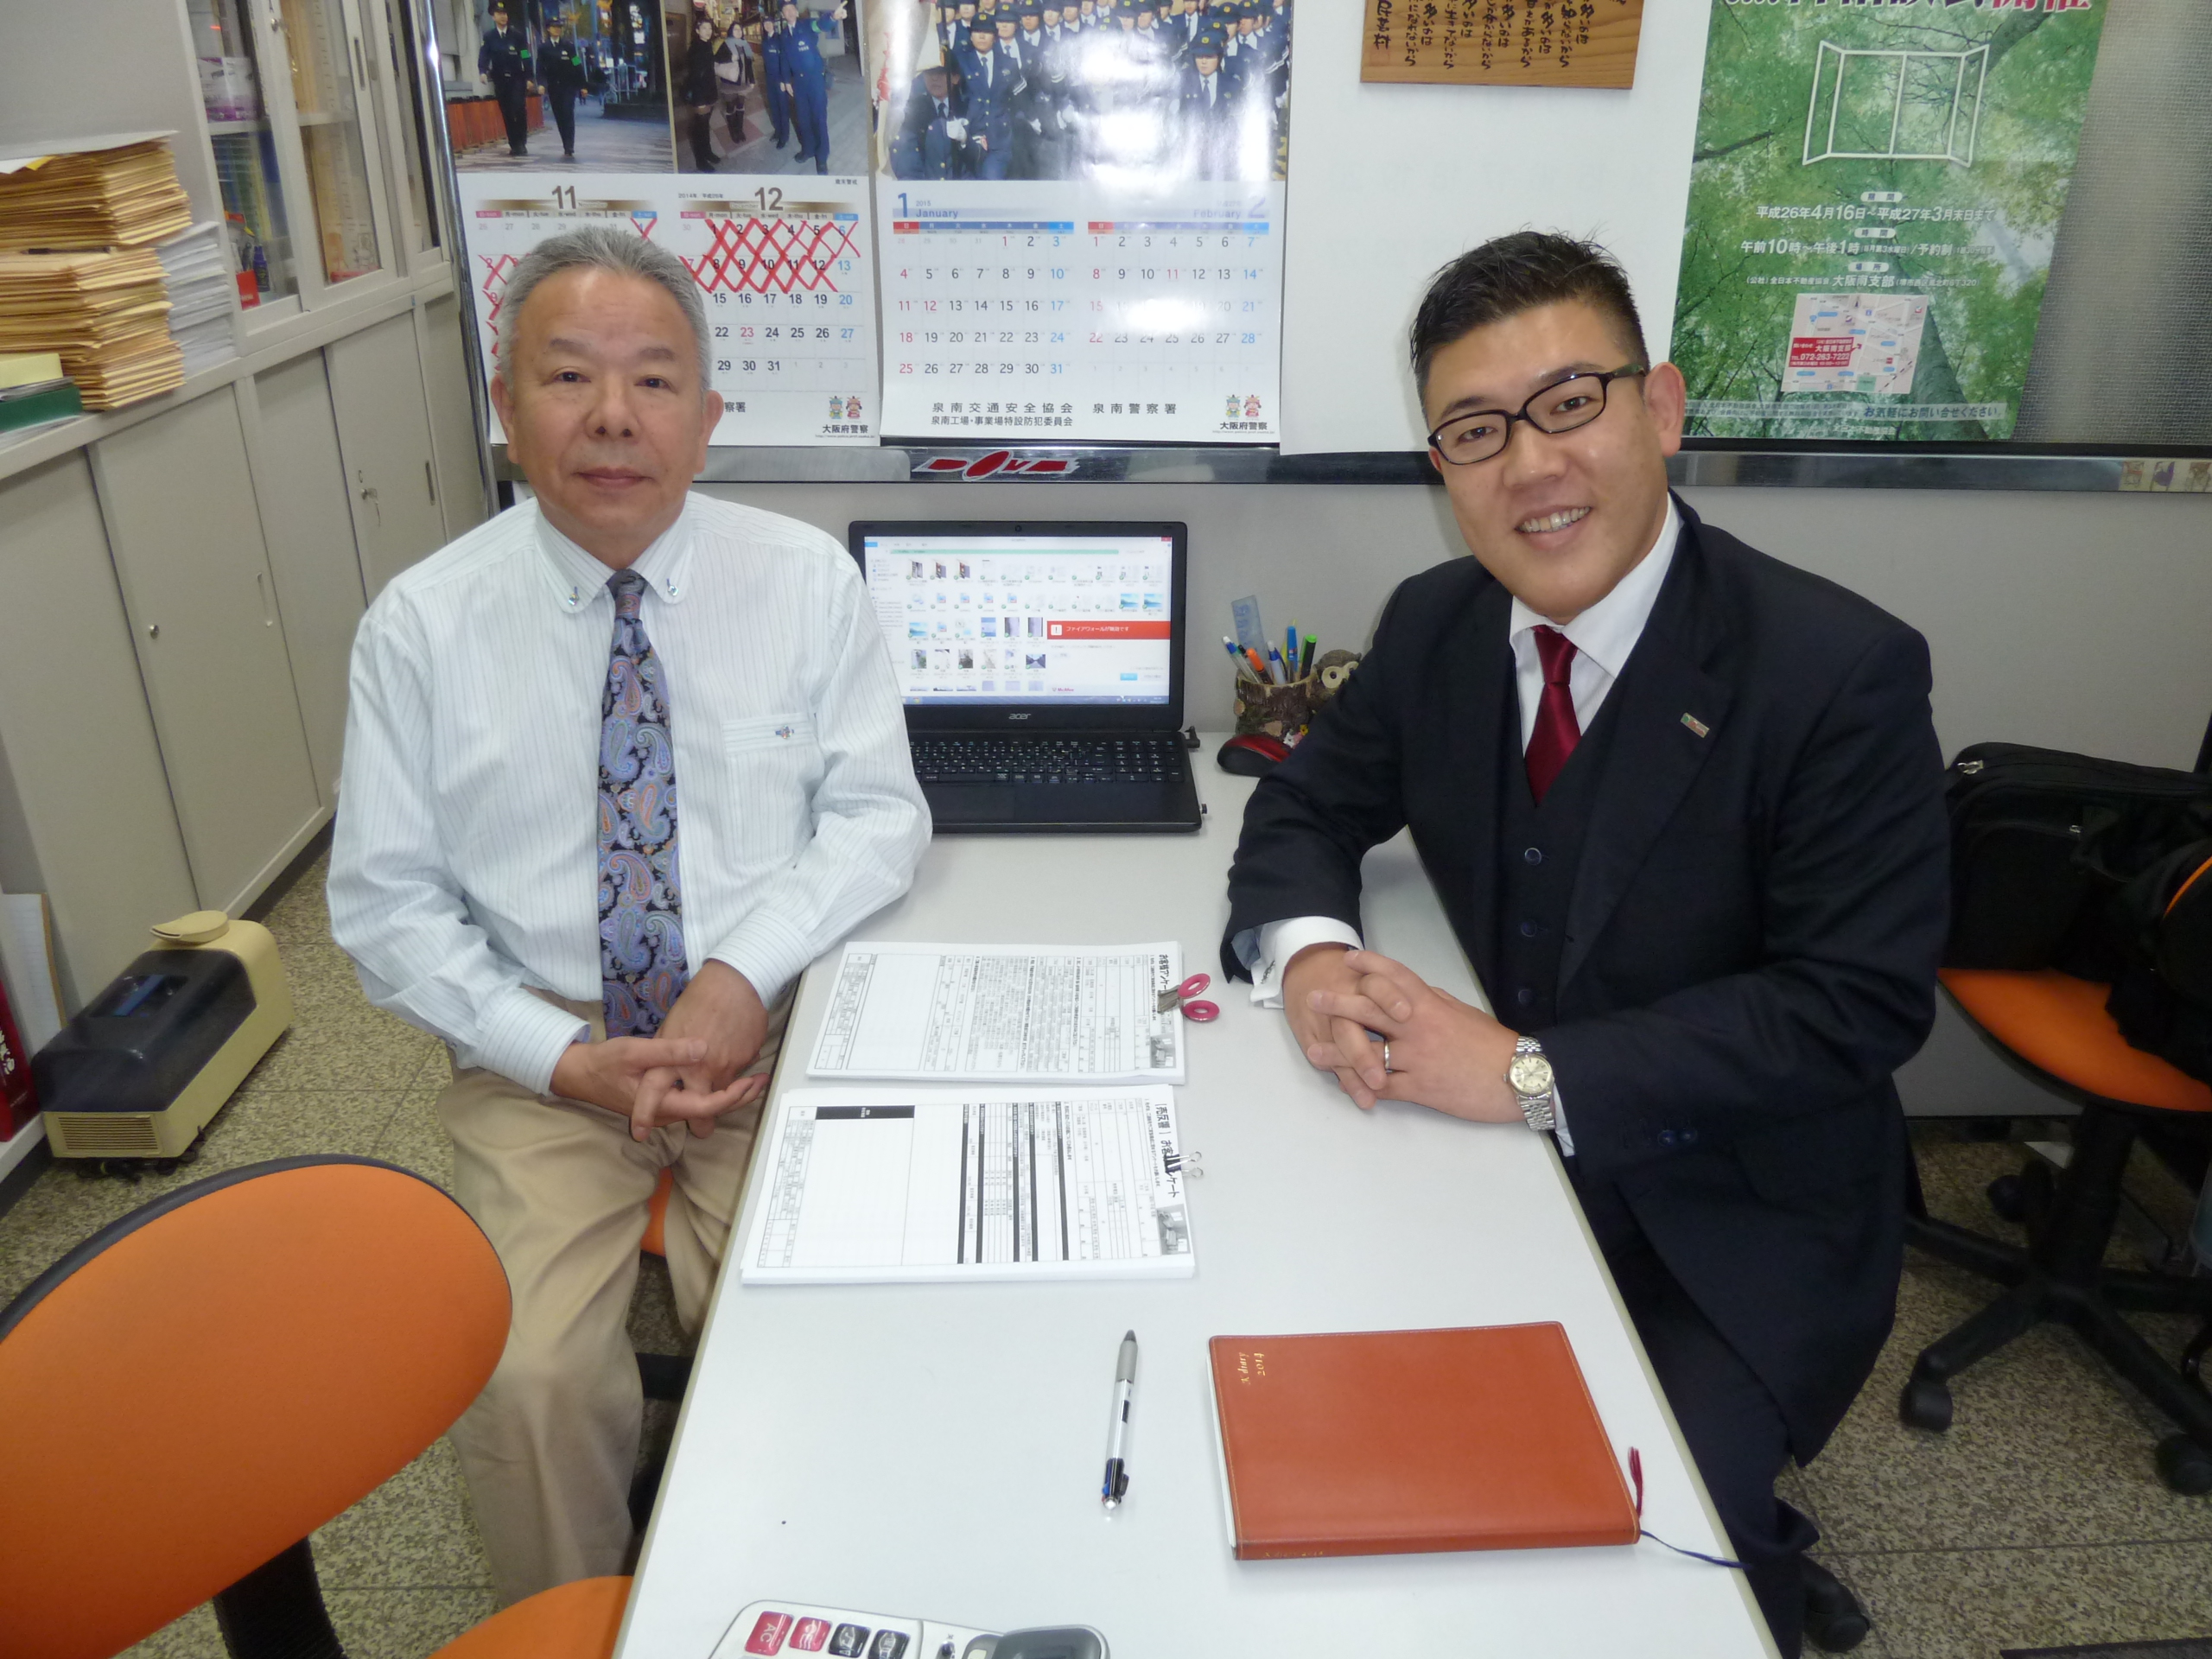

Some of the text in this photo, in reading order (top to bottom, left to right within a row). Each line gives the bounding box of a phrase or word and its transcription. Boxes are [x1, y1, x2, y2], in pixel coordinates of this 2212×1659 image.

[552, 186, 576, 209] 11
[754, 187, 784, 211] 12
[897, 193, 908, 218] 1
[916, 208, 958, 219] January
[1193, 209, 1241, 219] February
[712, 225, 716, 233] 1
[737, 225, 743, 234] 2
[762, 226, 769, 234] 3
[788, 226, 795, 234] 4
[814, 226, 820, 235] 5
[839, 226, 846, 235] 6
[1003, 236, 1059, 246] 1 2 3
[1094, 237, 1255, 247] 1 2 3 4 5 6 7
[713, 259, 720, 268] 8
[740, 259, 746, 269] 9
[762, 259, 775, 269] 10
[788, 260, 799, 270] 11
[813, 260, 825, 270] 12
[838, 261, 850, 270] 13
[900, 269, 1064, 279] 4 5 6 7 8 9 10
[1093, 269, 1256, 279] 8 9 10 11 12 13 14
[713, 293, 852, 305] 15 16 17 18 19 20
[899, 301, 1064, 310] 11 12 13 14 15 16 17
[1243, 301, 1255, 312] 21
[715, 327, 854, 338] 22 23 24 25 26 27
[900, 332, 1064, 342] 18 19 20 21 22 23 24
[1090, 333, 1103, 342] 22
[1191, 333, 1205, 343] 26
[1217, 334, 1230, 343] 27
[1242, 333, 1255, 343] 28
[718, 360, 779, 371] 29 30 31
[899, 364, 1062, 373] 25 26 27 28 29 30 31
[932, 403, 1176, 414] 泉南交通安全協会 泉南警察署
[823, 424, 868, 433] 大阪府警察
[1220, 422, 1268, 430] 大阪府警察
[1237, 1351, 1249, 1374] diary
[1254, 1352, 1266, 1376] 2014
[760, 1623, 776, 1643] AC
